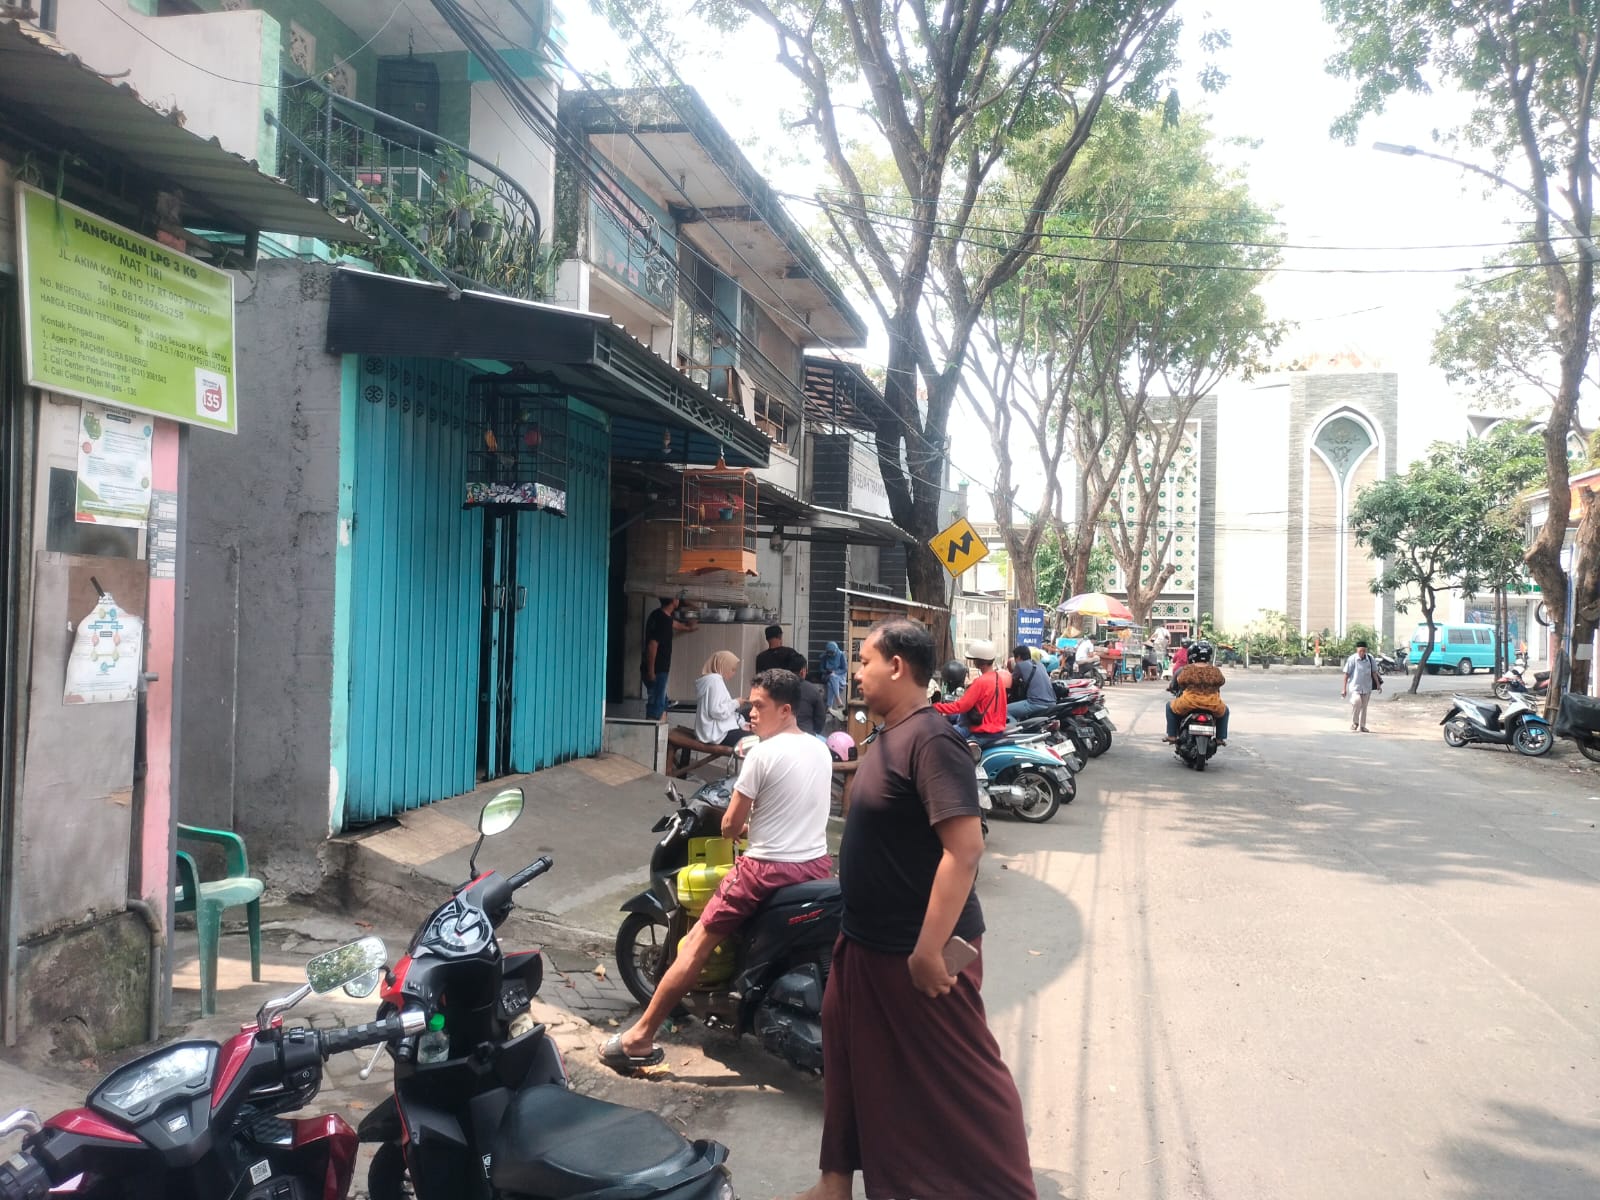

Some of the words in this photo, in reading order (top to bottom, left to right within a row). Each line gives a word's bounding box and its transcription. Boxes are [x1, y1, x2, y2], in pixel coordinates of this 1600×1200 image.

[74, 217, 146, 258] PANGKALAN
[150, 249, 170, 268] LPG
[173, 260, 179, 272] 3
[183, 264, 197, 280] KG
[119, 252, 141, 273] MAT
[144, 263, 162, 281] TIRI
[100, 263, 126, 283] KAYAT
[129, 274, 143, 289] NO
[146, 281, 155, 294] 17
[97, 279, 119, 298] Telp.
[40, 292, 65, 308] HARGA
[40, 313, 65, 330] Kontak
[203, 391, 220, 409] 135
